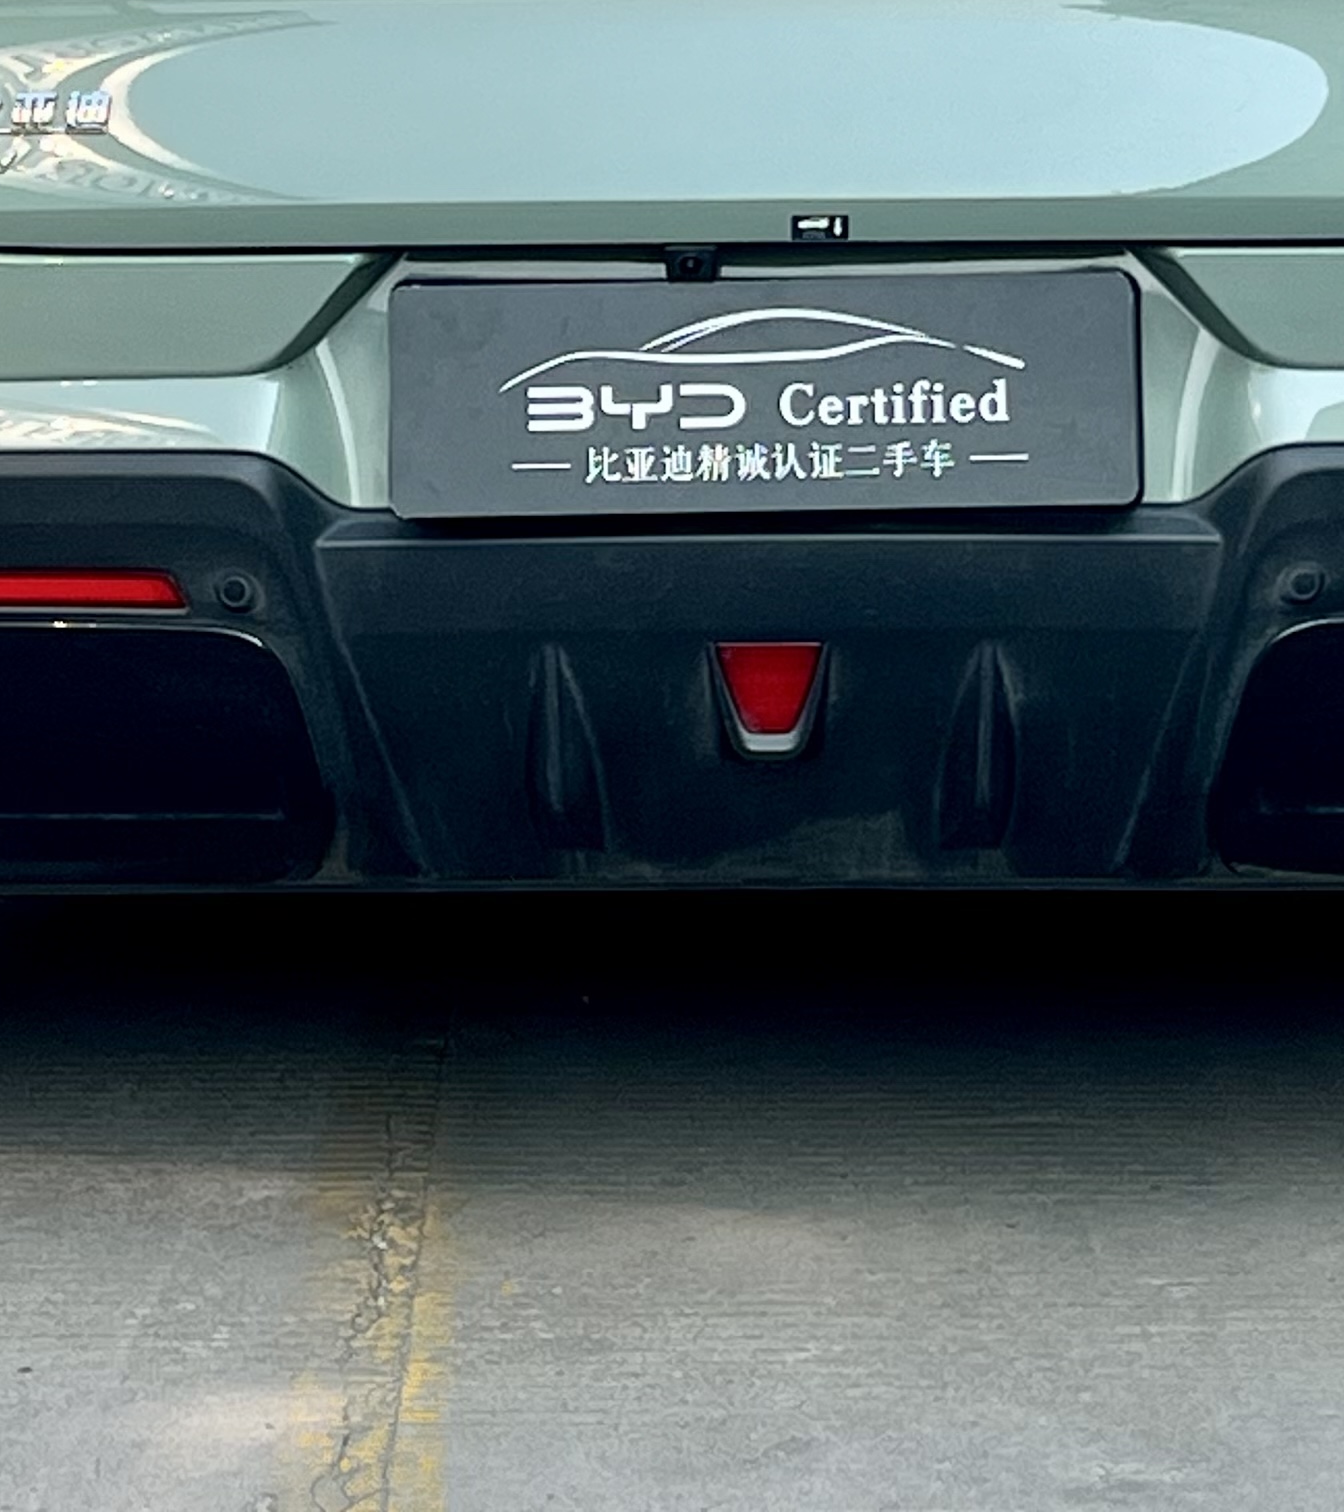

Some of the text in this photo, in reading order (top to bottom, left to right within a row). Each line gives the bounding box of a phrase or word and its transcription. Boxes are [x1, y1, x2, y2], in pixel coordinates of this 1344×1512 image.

[526, 378, 1011, 432] BYD Certified
[584, 442, 956, 484] 比亚迪精诚认证二手车
